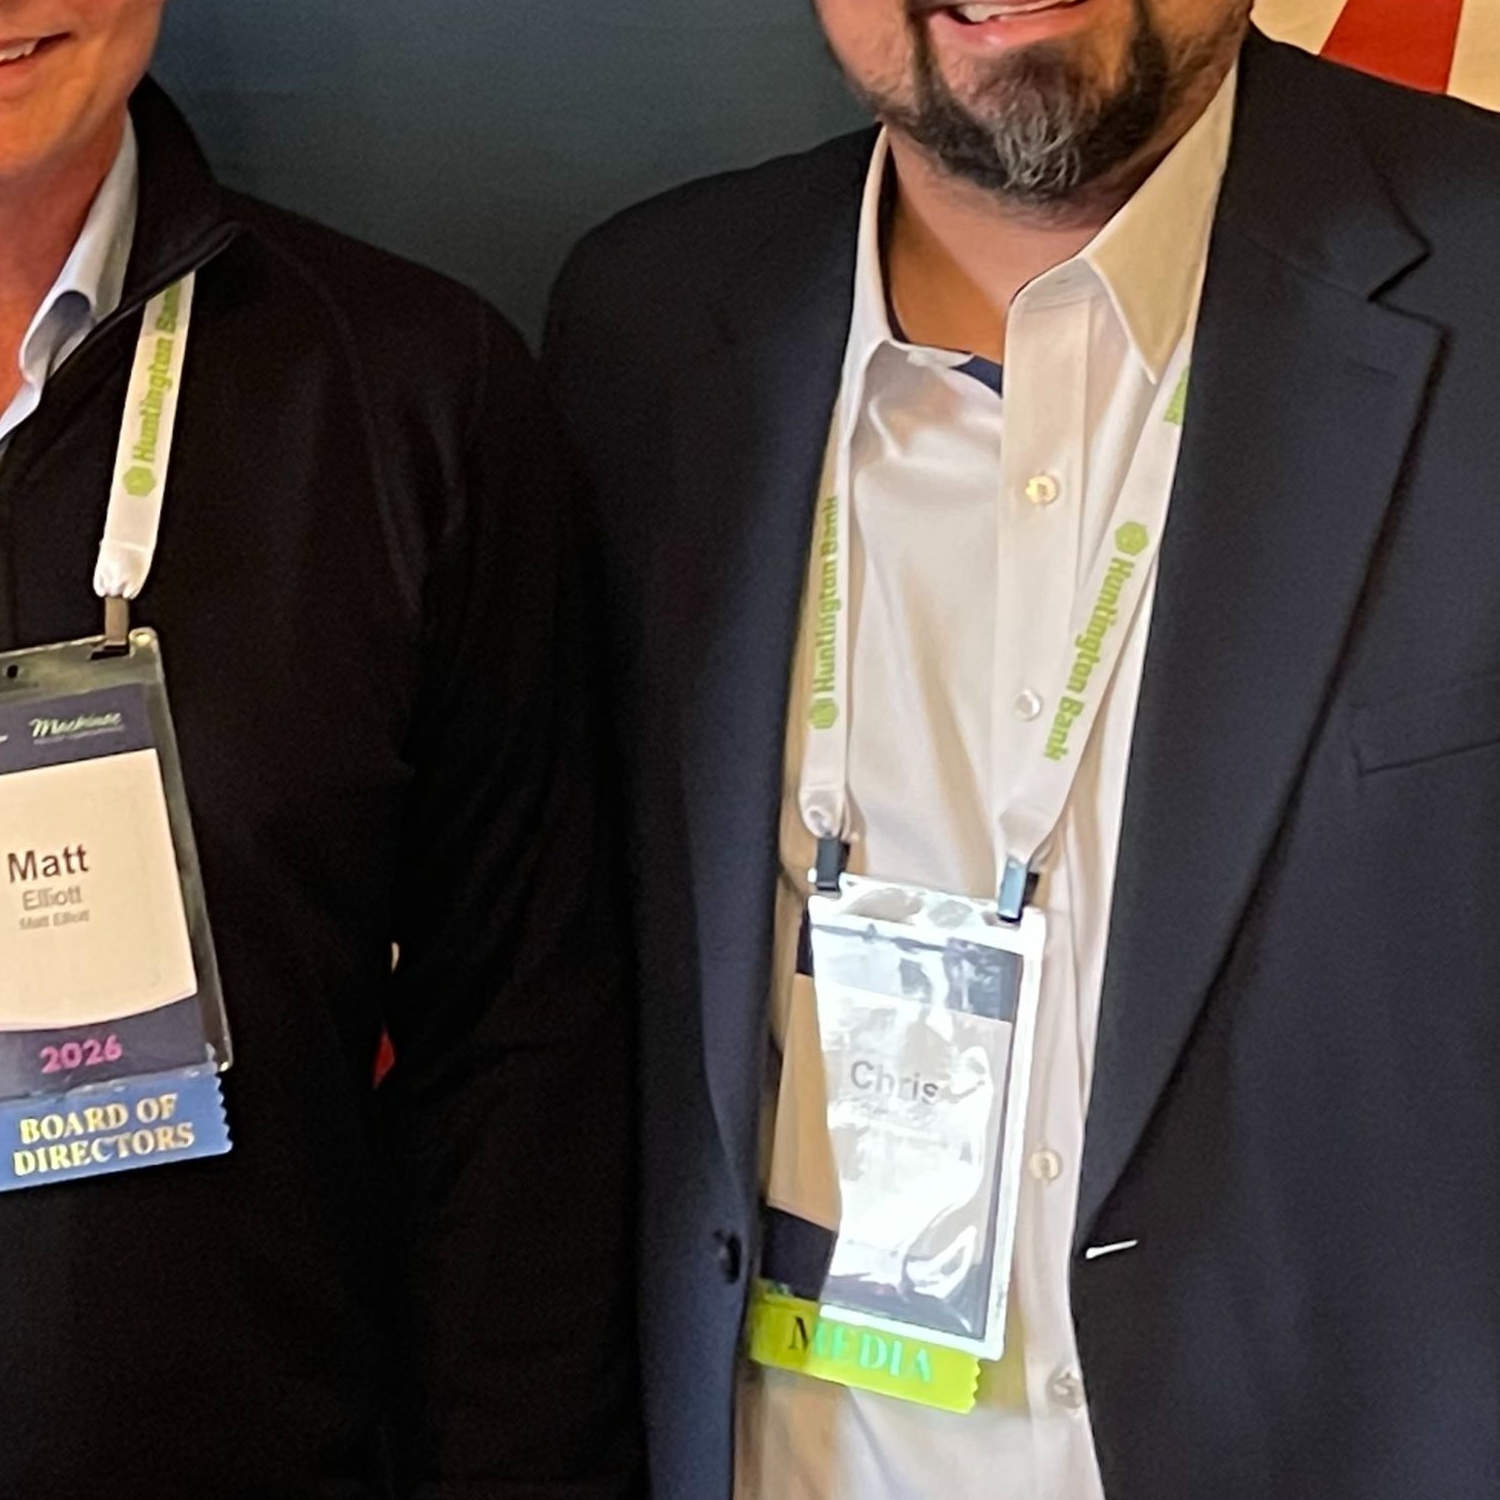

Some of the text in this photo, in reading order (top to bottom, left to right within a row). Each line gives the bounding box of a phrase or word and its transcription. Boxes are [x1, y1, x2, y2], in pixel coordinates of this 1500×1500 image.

[131, 283, 181, 463] Huntington Ban
[813, 561, 842, 693] Huntington
[1043, 556, 1135, 762] Huntington Bank
[7, 844, 89, 884] Matt
[40, 1035, 124, 1074] 2026
[850, 1060, 940, 1105] Chris
[19, 1093, 178, 1145] BOARD OF
[13, 1122, 196, 1176] DIRECTORS
